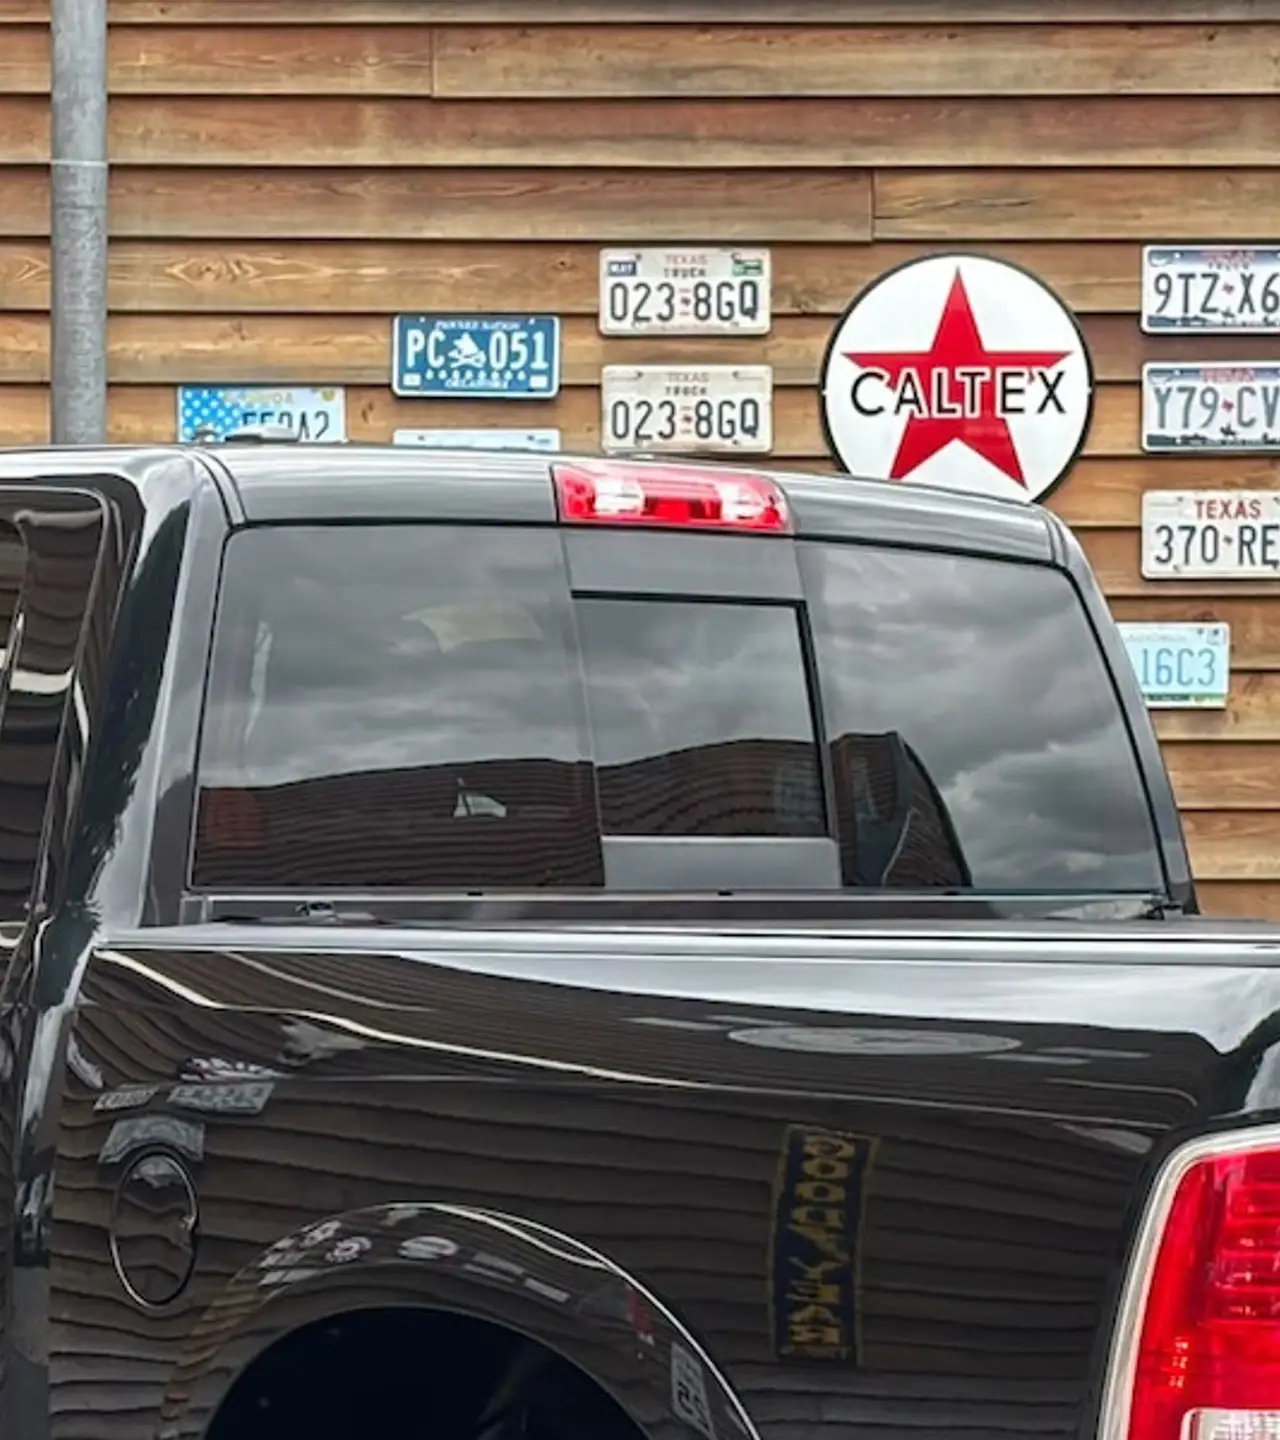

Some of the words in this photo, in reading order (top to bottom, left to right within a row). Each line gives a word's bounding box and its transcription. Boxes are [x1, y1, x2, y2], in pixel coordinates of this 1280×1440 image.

[665, 254, 709, 265] TEXAS
[406, 329, 446, 368] PC
[489, 331, 549, 370] 051
[850, 370, 1067, 417] CALTEX
[1194, 500, 1261, 519] TEXAS
